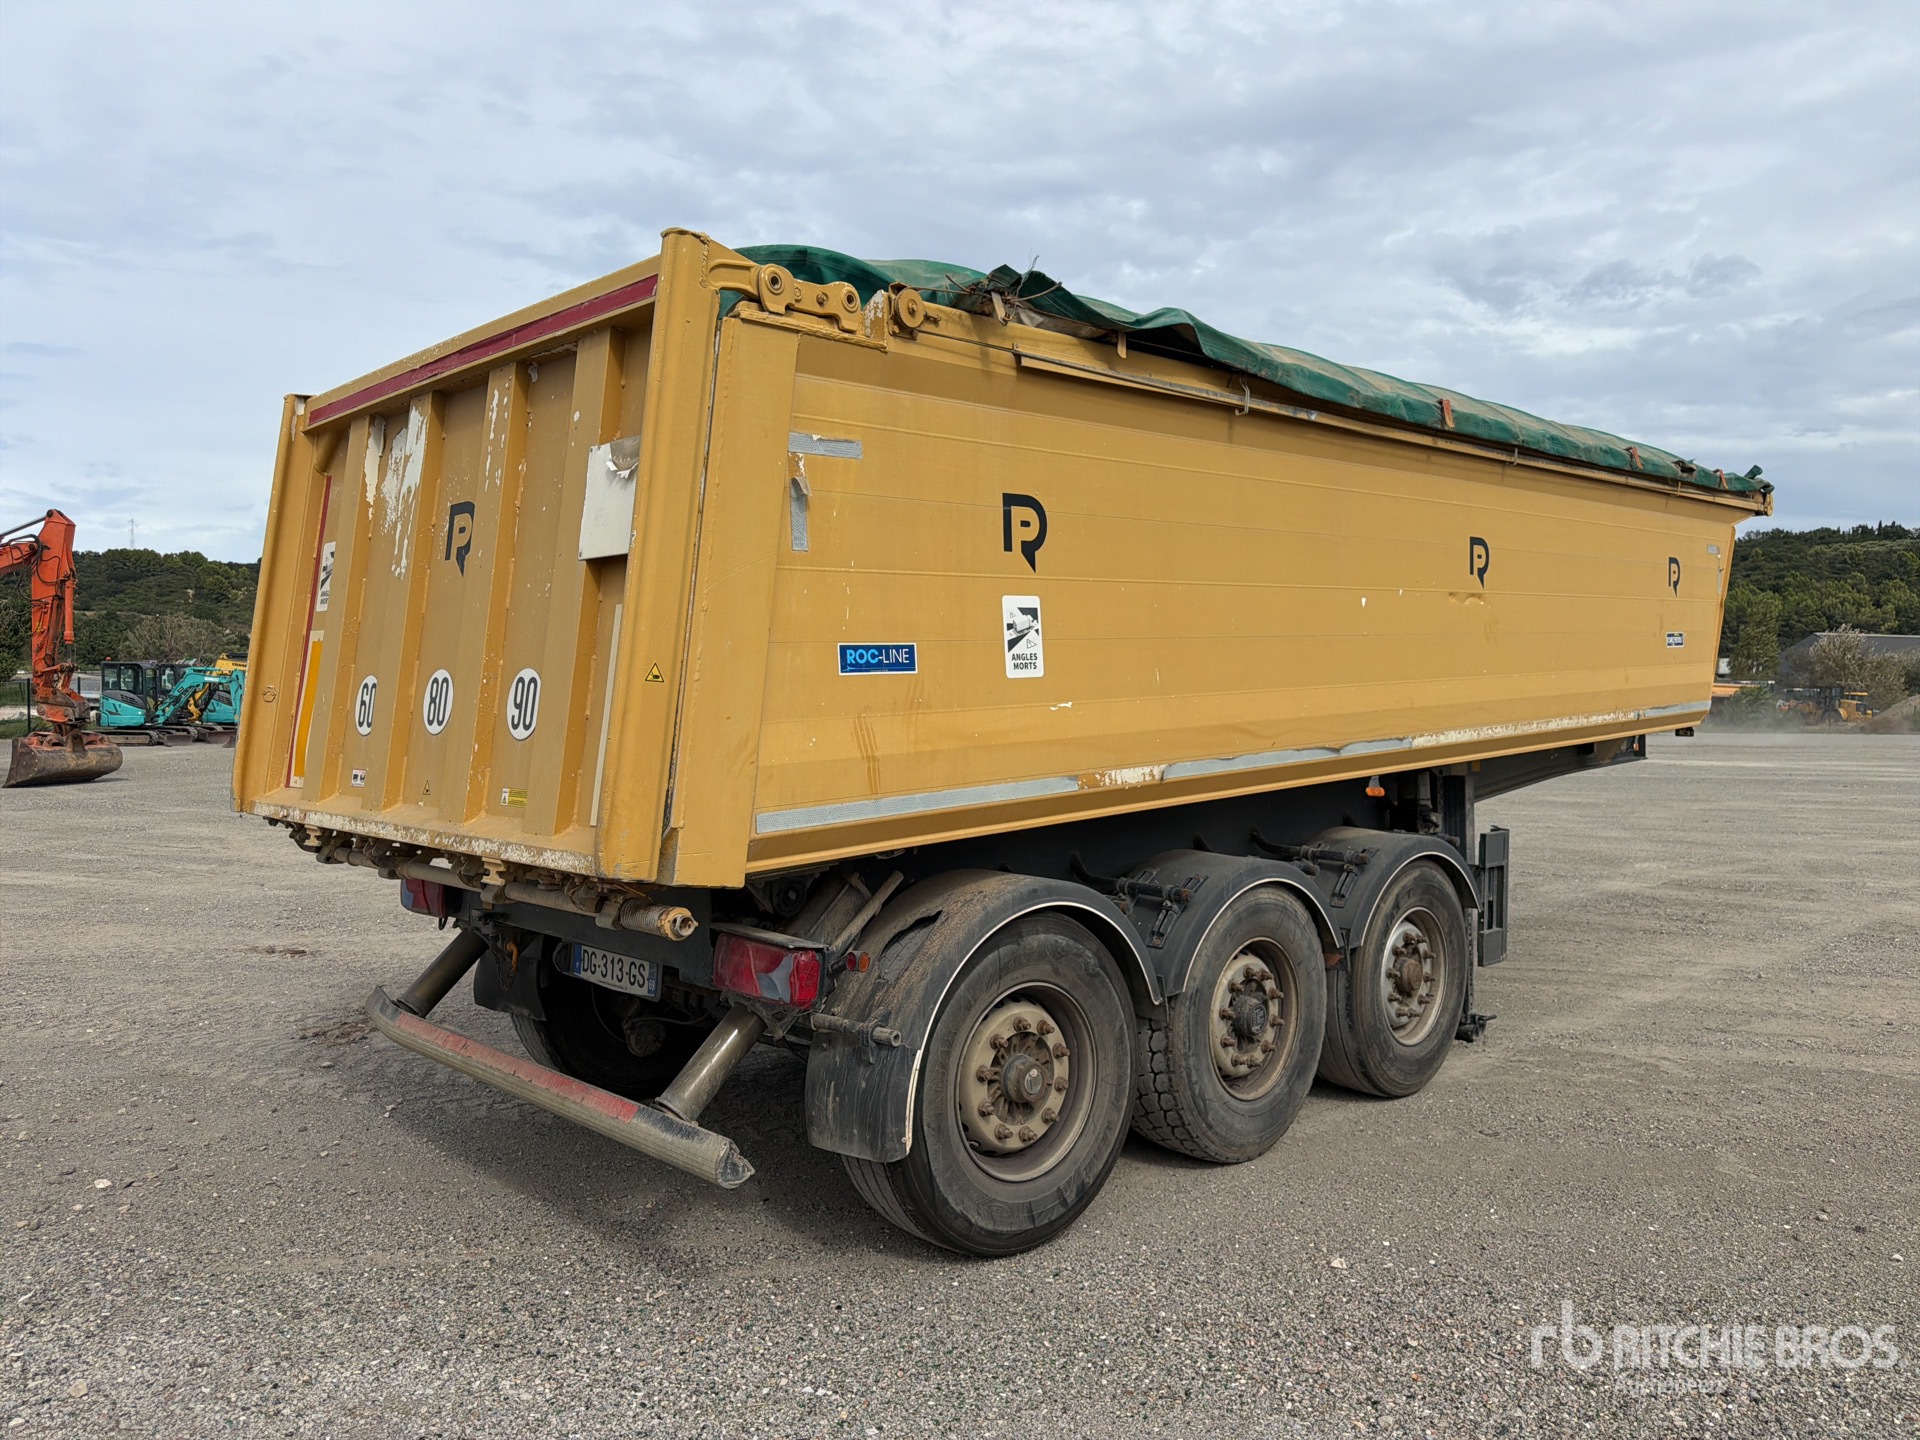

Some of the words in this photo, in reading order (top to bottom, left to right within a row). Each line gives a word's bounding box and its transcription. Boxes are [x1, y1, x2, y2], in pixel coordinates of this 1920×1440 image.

[846, 648, 910, 664] ROC-LINE
[1011, 652, 1038, 661] ANGLES
[1013, 661, 1038, 670] MORTS
[358, 682, 377, 728] 60
[427, 676, 450, 727] 80
[511, 676, 537, 731] 90
[582, 949, 646, 988] DG-313-GS
